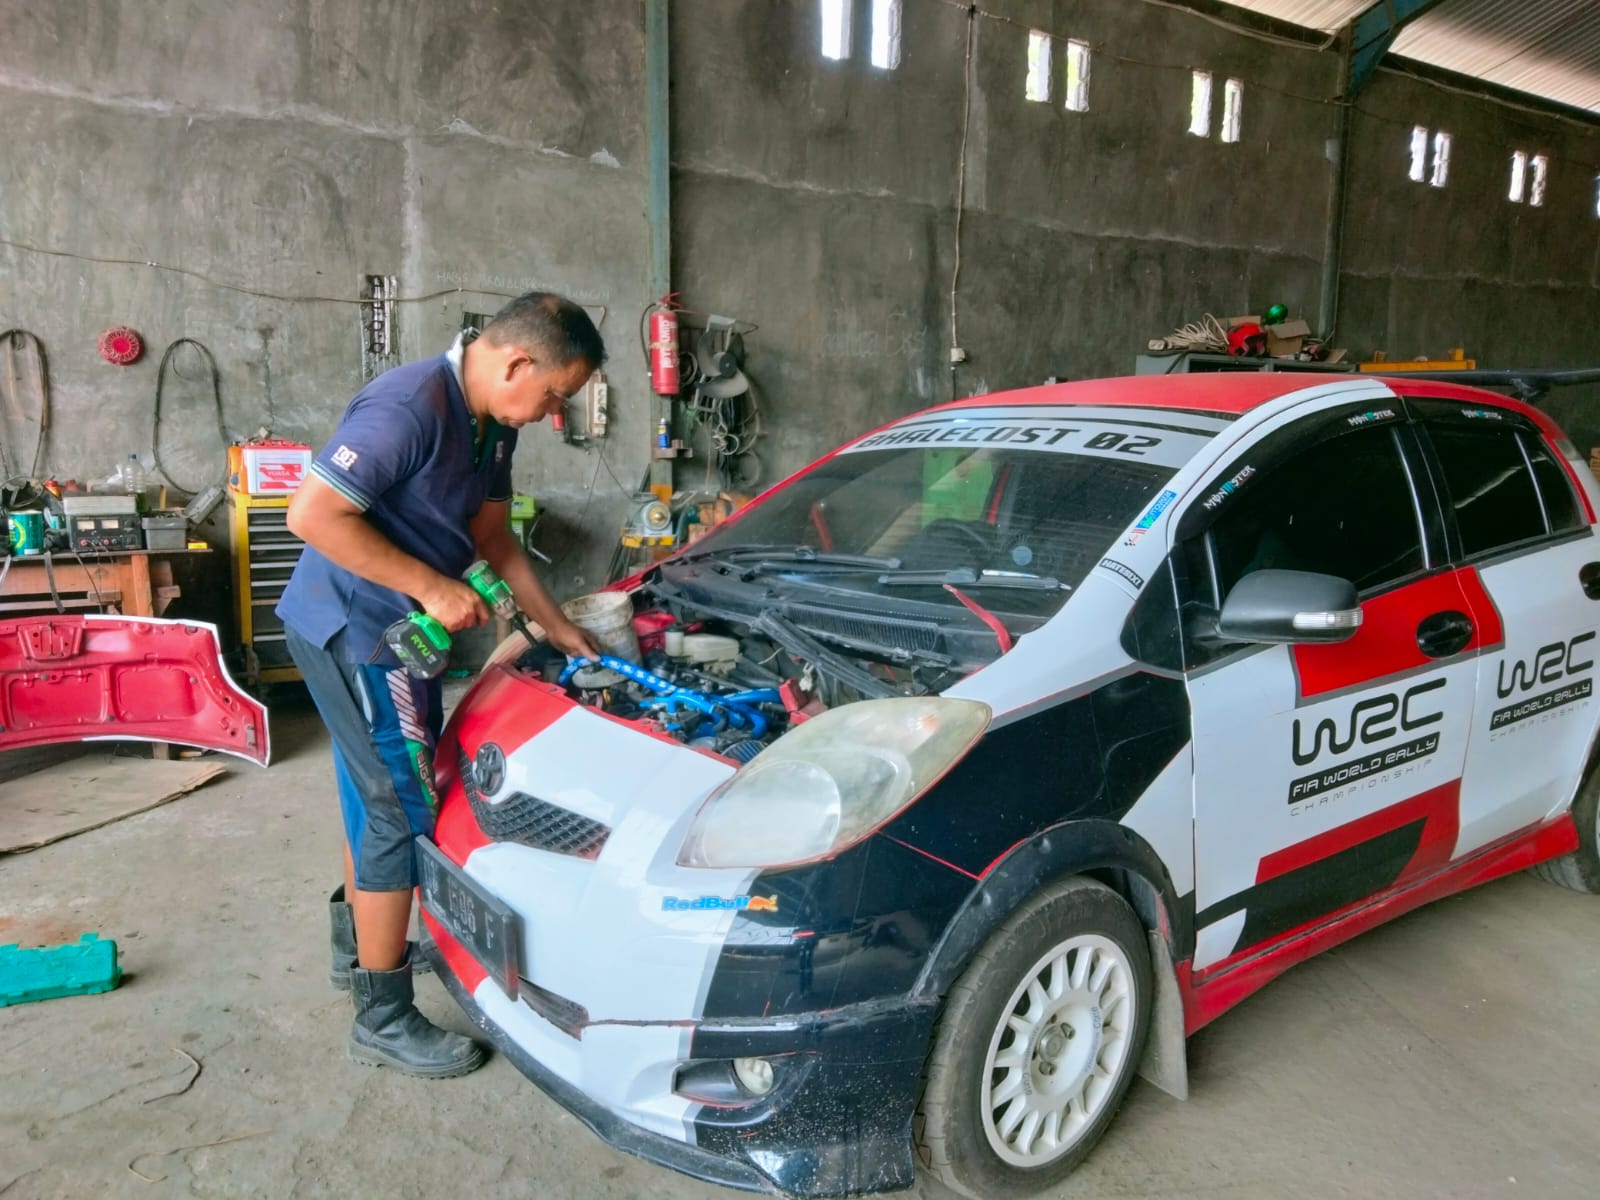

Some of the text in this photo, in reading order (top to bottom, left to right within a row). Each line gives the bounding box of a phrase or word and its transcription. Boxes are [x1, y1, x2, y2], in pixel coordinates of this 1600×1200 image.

[410, 633, 432, 657] RYU
[1497, 630, 1597, 698] WRC
[1292, 677, 1447, 766] WRC
[1493, 683, 1591, 725] FIA WORLD RALLY
[1290, 758, 1433, 817] CHAMPIONSHIP
[1292, 737, 1437, 797] FIA WORLD RALLY
